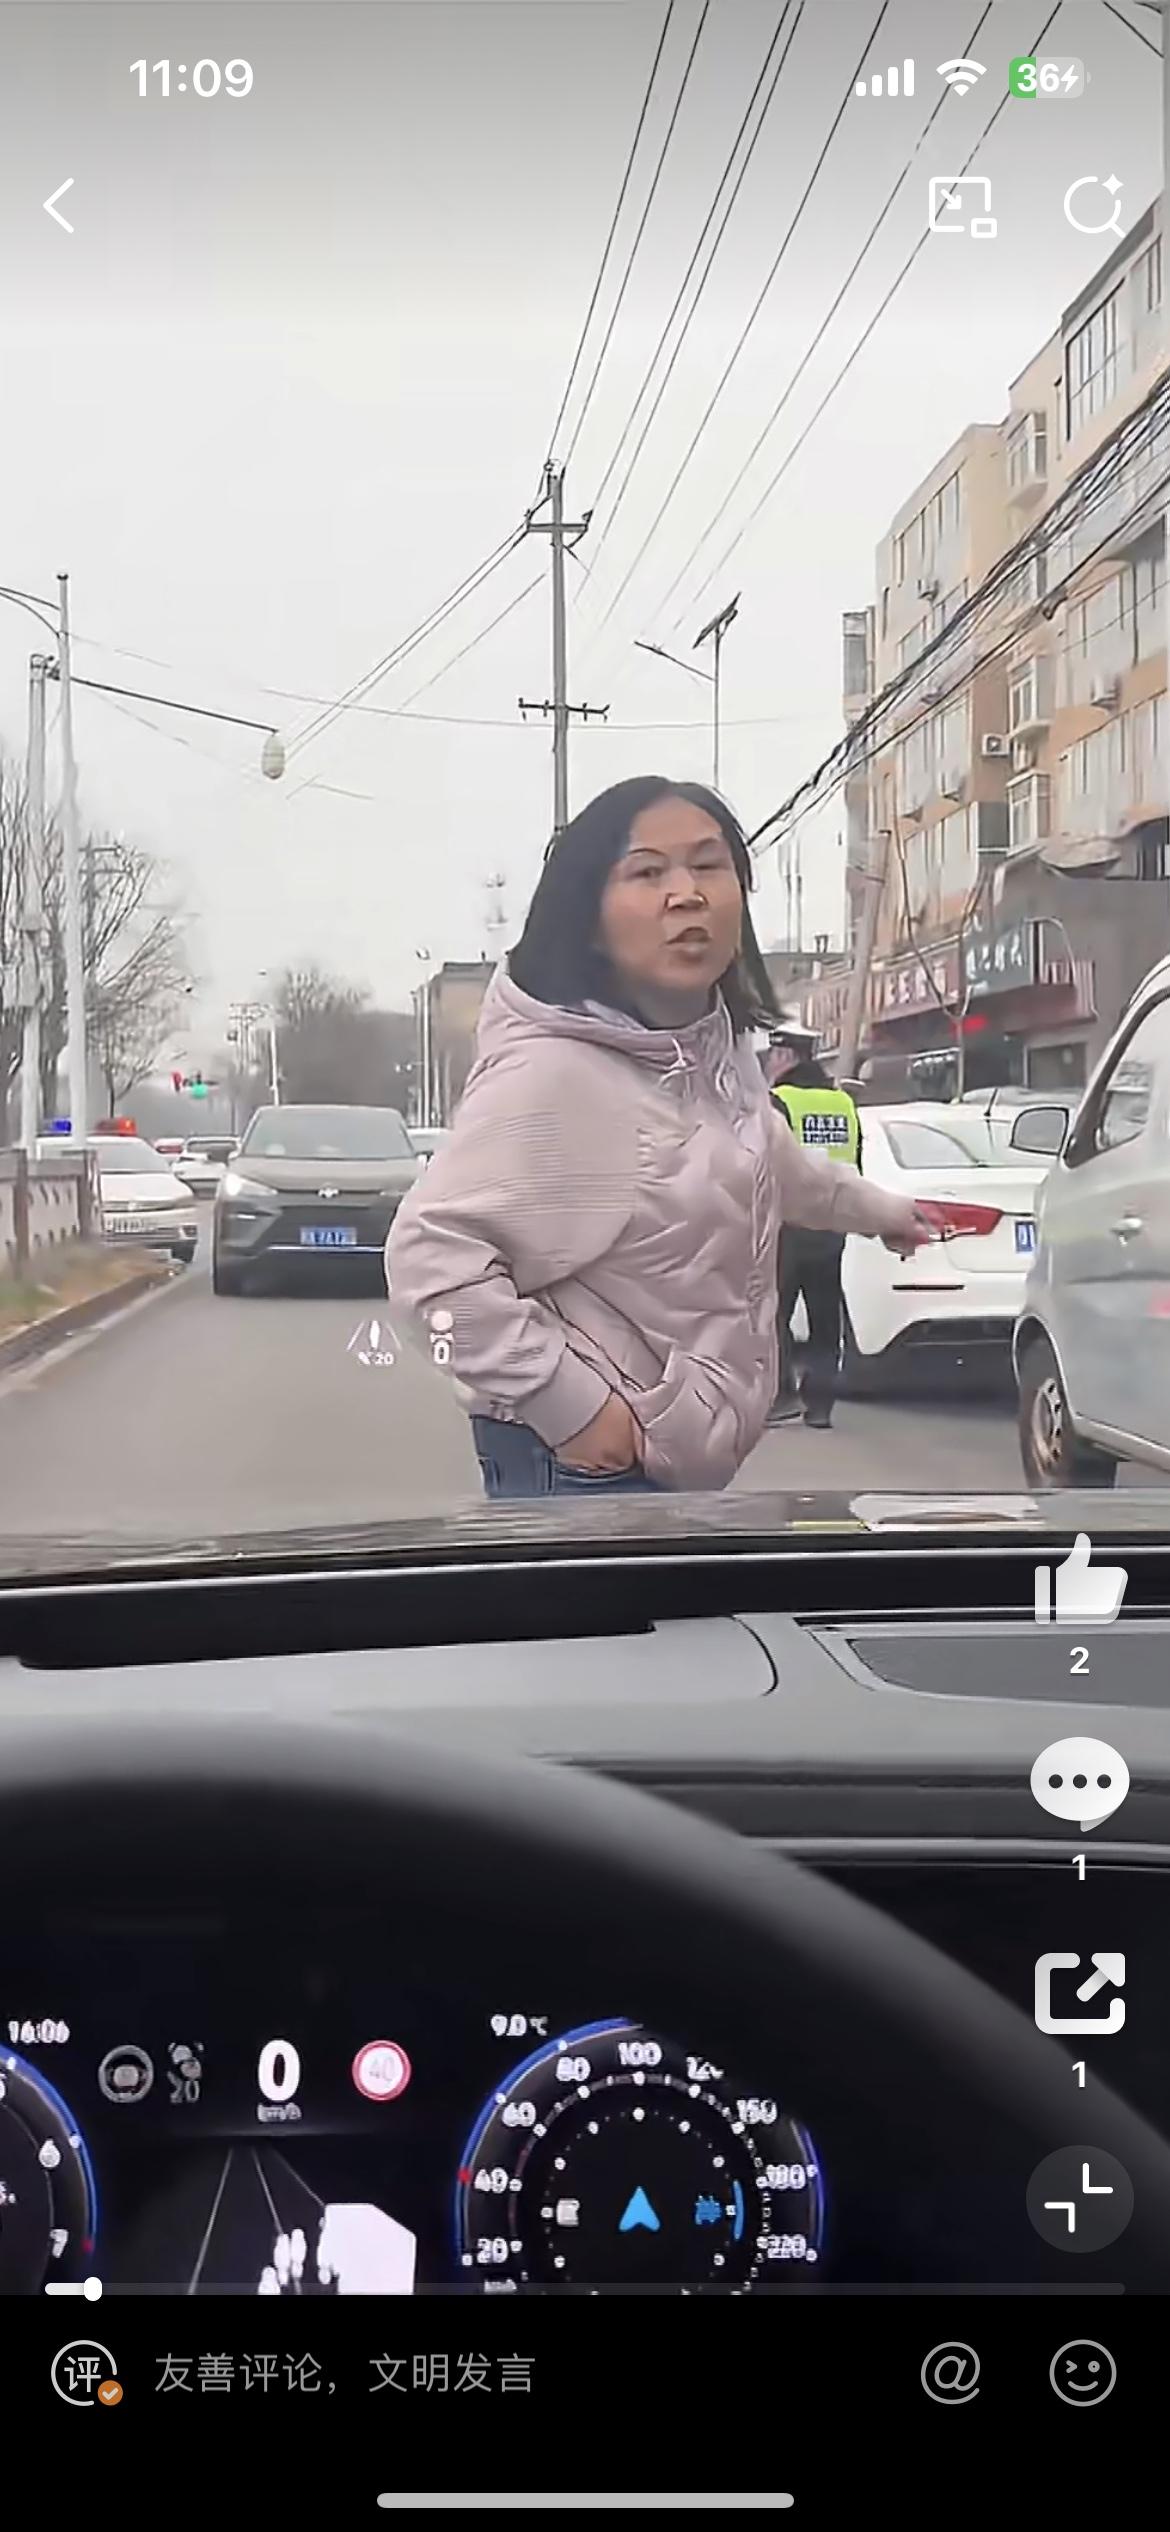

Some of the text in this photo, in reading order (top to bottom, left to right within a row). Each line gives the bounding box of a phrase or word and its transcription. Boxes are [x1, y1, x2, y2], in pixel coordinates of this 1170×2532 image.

[617, 2042, 663, 2067] 100
[257, 2039, 301, 2102] 0
[555, 2056, 591, 2082] 80
[473, 2167, 509, 2194] 40
[476, 2237, 509, 2264] 20
